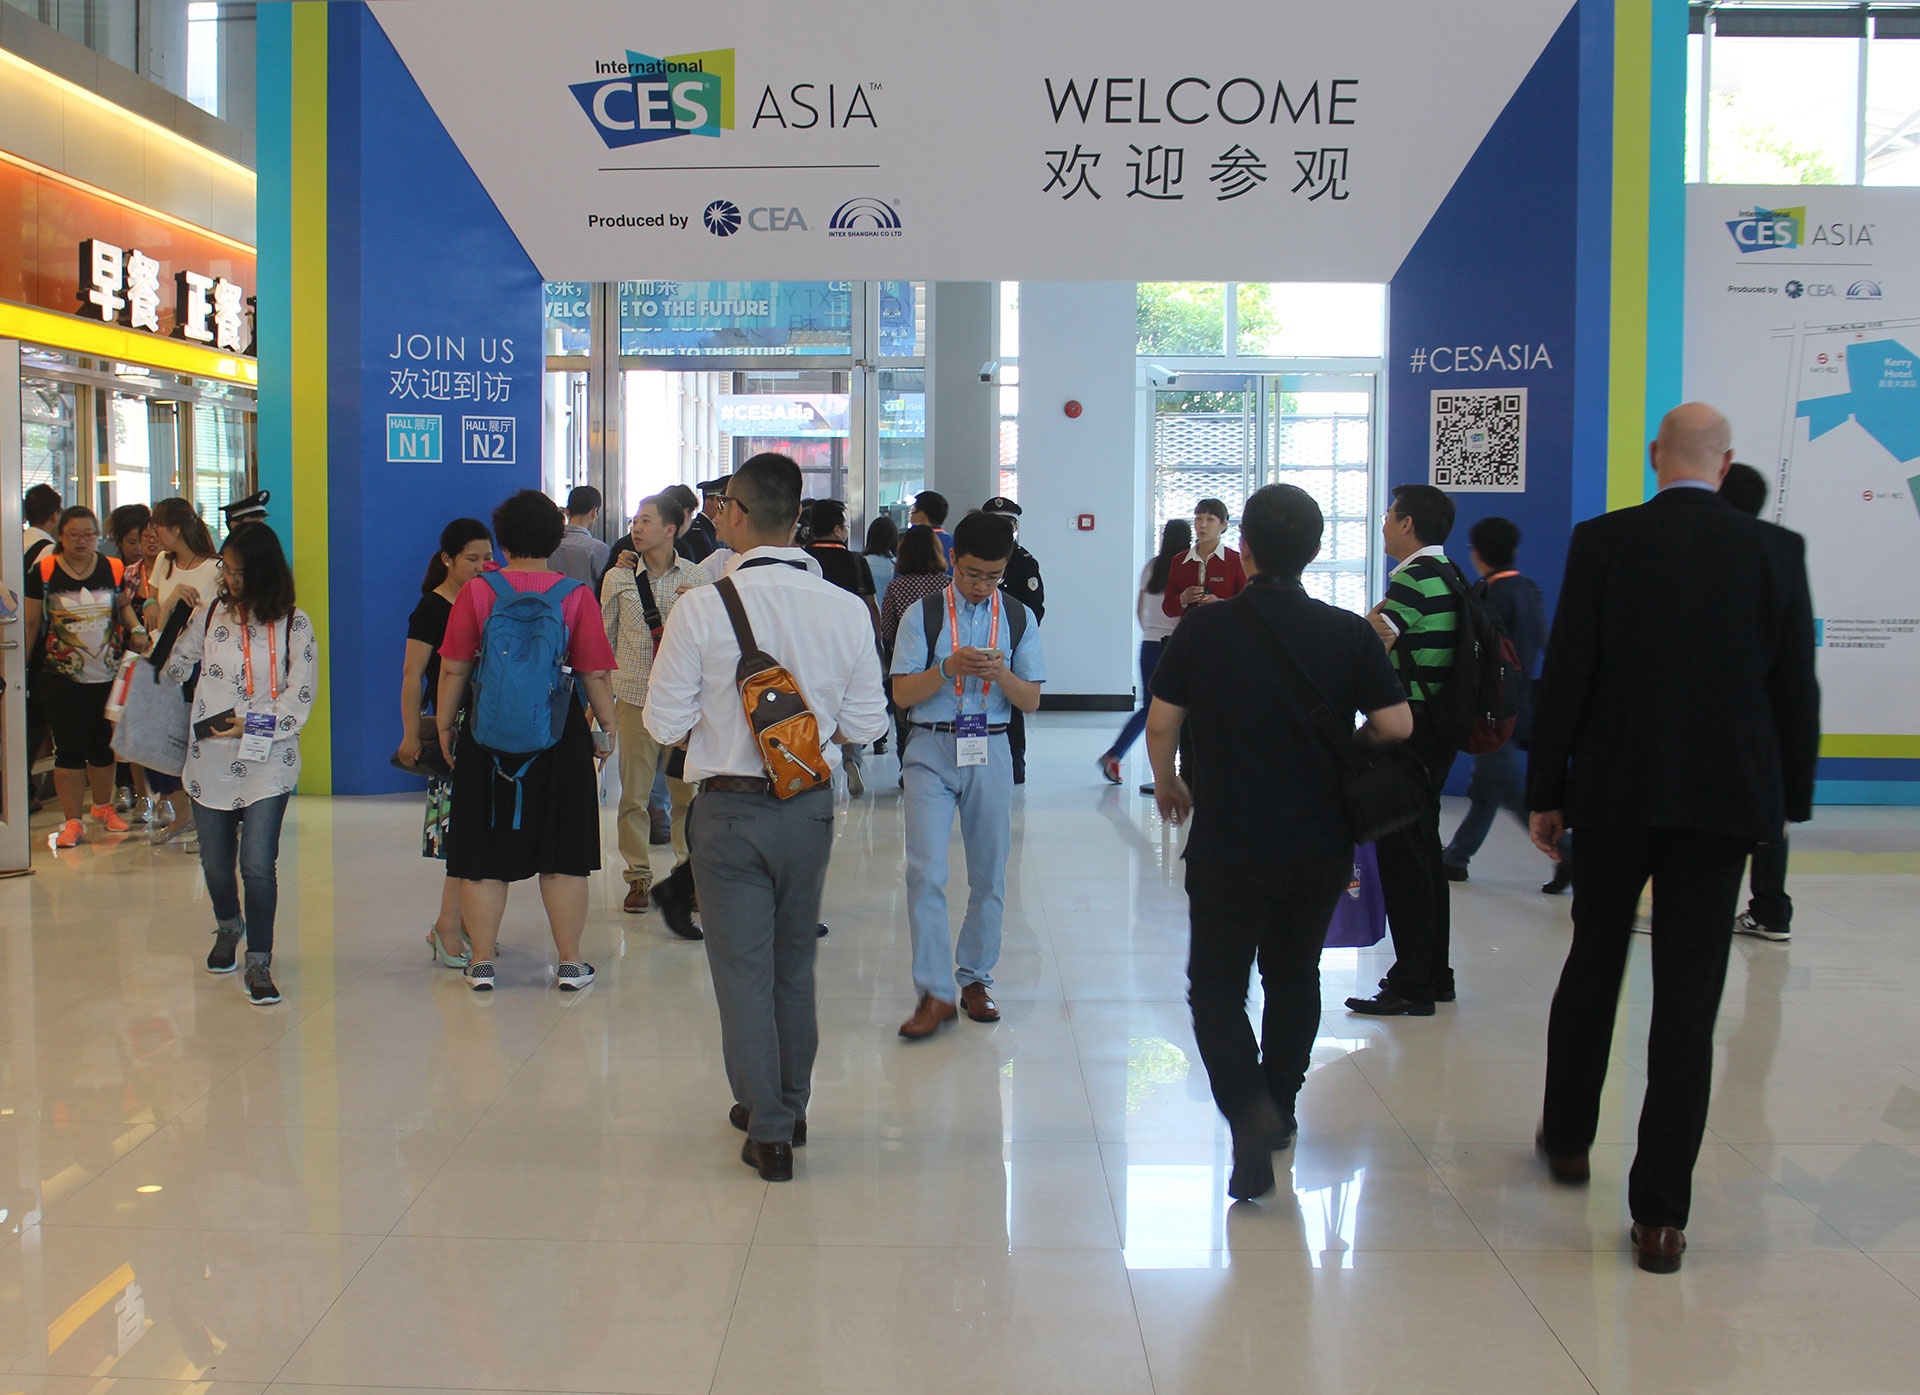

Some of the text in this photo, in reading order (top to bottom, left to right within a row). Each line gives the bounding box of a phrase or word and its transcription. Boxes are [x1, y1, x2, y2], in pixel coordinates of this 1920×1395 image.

[595, 59, 703, 74] International
[1044, 77, 1359, 125] WELCOME
[1042, 143, 1350, 202] 欢迎参观
[588, 213, 689, 230] Produced by
[748, 206, 808, 231] CEA
[1739, 210, 1792, 218] International
[1735, 221, 1792, 245] CES
[1728, 285, 1778, 295] Produced by
[632, 301, 658, 317] TO
[662, 301, 696, 317] THE
[700, 301, 768, 317] FUTURE
[389, 333, 515, 364] JOIN US
[1410, 343, 1553, 373] #CESASIA
[1884, 357, 1912, 369] Kerry
[1884, 370, 1912, 379] Hotel
[389, 368, 513, 402] 欢迎到访
[720, 404, 814, 421] #CESAsia
[390, 418, 438, 431] HALL 展厅
[466, 420, 511, 432] HALL 展厅
[399, 433, 430, 457] N1
[472, 434, 505, 459] N2
